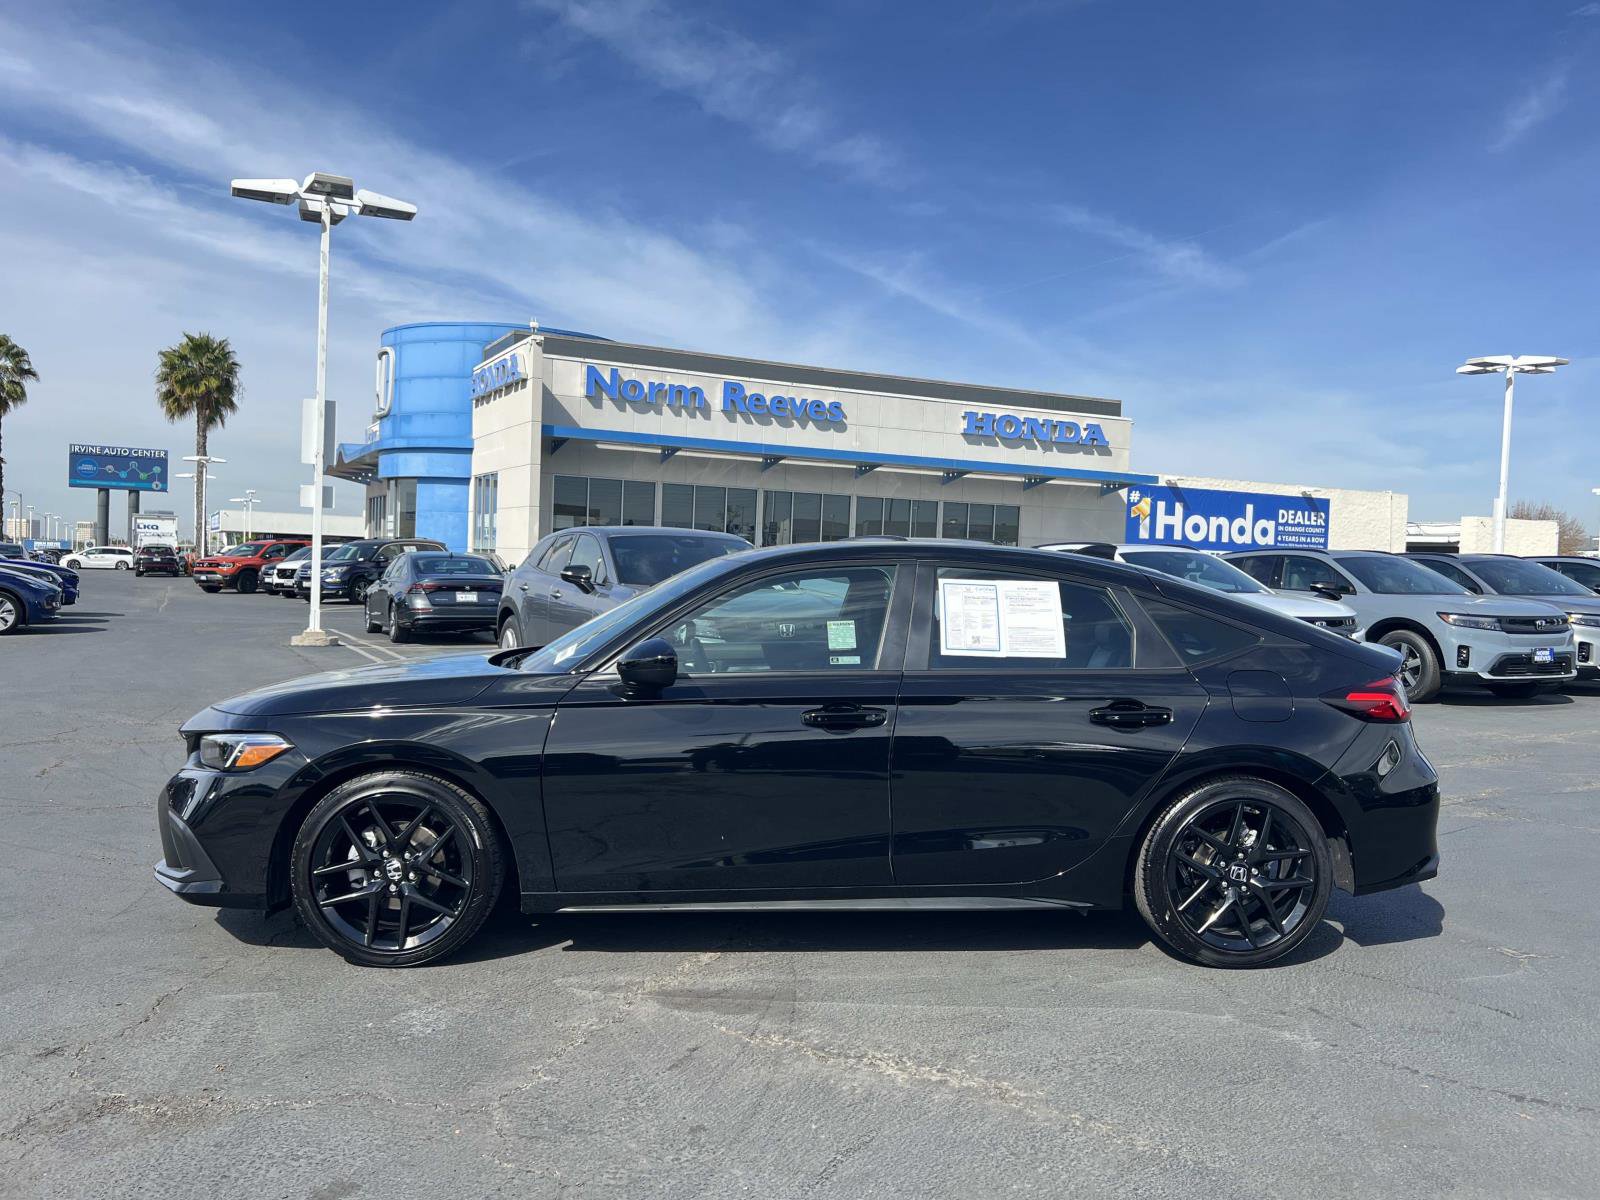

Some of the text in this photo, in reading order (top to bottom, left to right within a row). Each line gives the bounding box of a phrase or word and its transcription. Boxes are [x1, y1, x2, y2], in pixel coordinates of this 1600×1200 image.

[585, 364, 844, 422] Norm Reeves
[962, 411, 1109, 446] HONDA
[71, 445, 165, 458] IRVINE AUTO CENTER
[1155, 501, 1276, 546] Honda
[1278, 509, 1325, 526] DEALER
